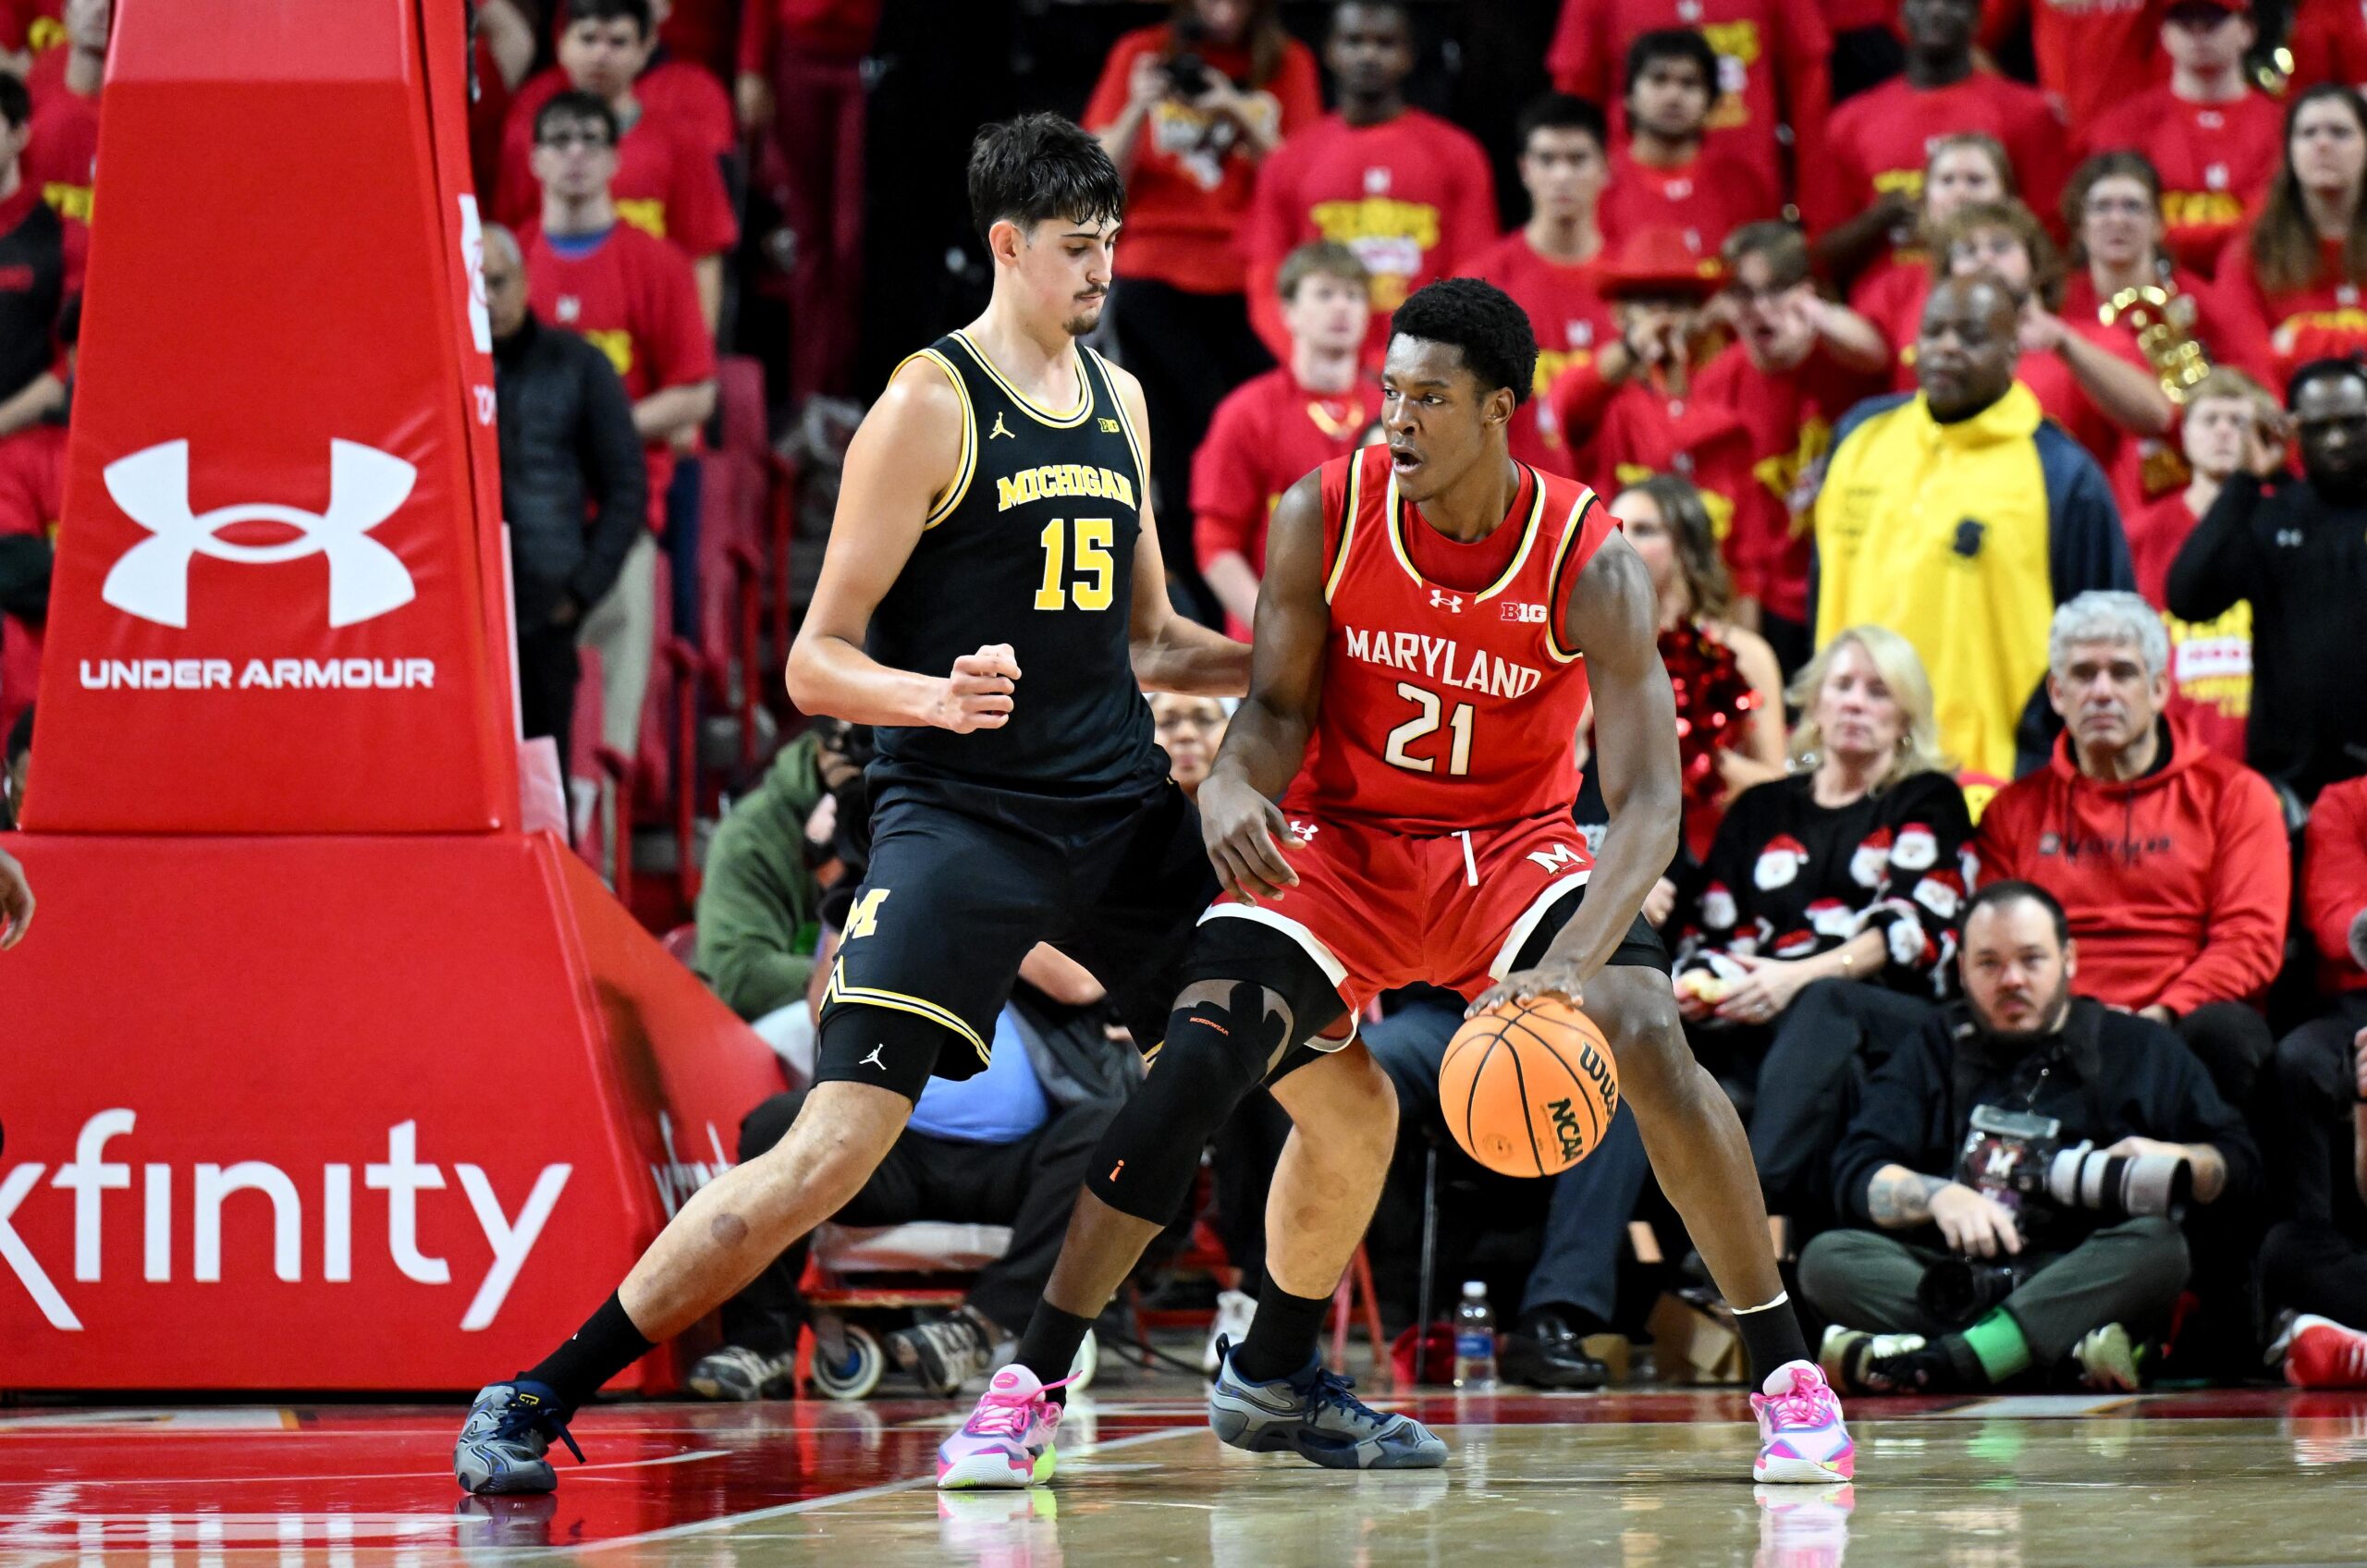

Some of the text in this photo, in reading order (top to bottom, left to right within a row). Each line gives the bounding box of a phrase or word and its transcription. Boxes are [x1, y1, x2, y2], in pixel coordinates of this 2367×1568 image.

[997, 464, 1136, 512] MICHIGAN
[1034, 518, 1114, 610] 15
[80, 657, 435, 690] UNDER ARMOUR
[1345, 625, 1541, 699] MARYLAND
[1384, 681, 1475, 776] 21
[1526, 843, 1587, 876] M
